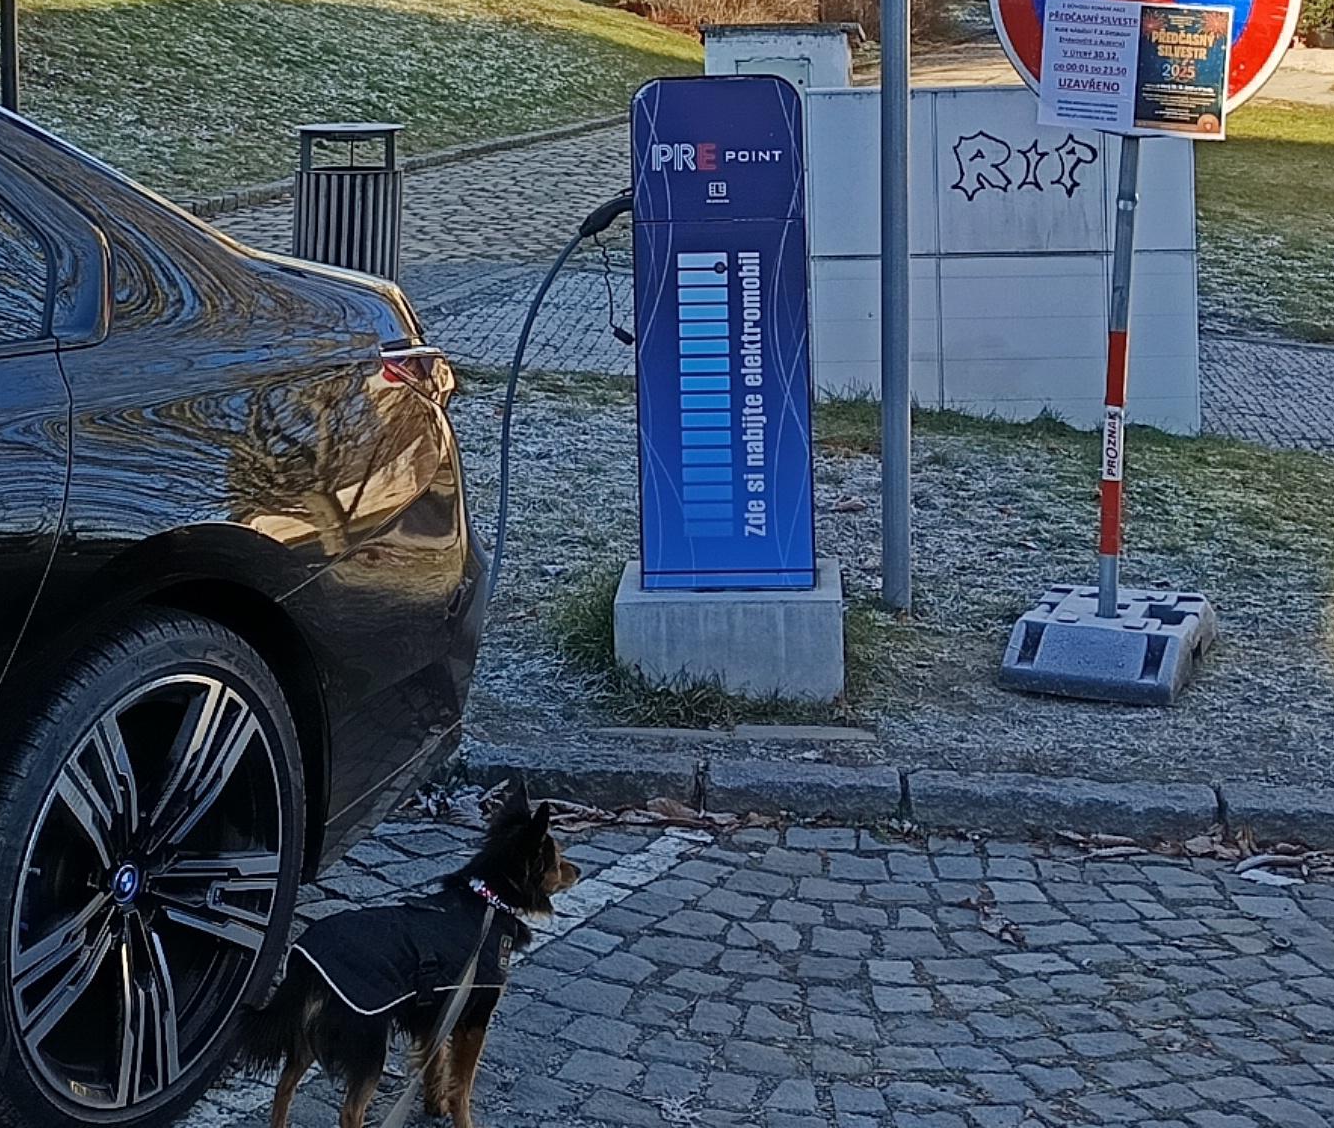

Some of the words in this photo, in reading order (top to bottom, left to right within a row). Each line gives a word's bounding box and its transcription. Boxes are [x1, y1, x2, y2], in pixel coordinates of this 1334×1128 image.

[1049, 10, 1099, 24] PŘEDČASNÝ
[1152, 29, 1215, 48] PŘEDČASNÝ
[1157, 45, 1207, 60] SILVESTR
[1162, 63, 1196, 78] 2025
[1058, 77, 1120, 92] UZAVŘENO
[651, 143, 717, 172] PRE
[725, 150, 783, 162] POINT
[738, 252, 763, 387] elektromobil
[742, 393, 767, 467] nabijte
[1105, 411, 1118, 477] PROZNAK
[744, 473, 765, 492] si
[744, 499, 766, 537] Zde
